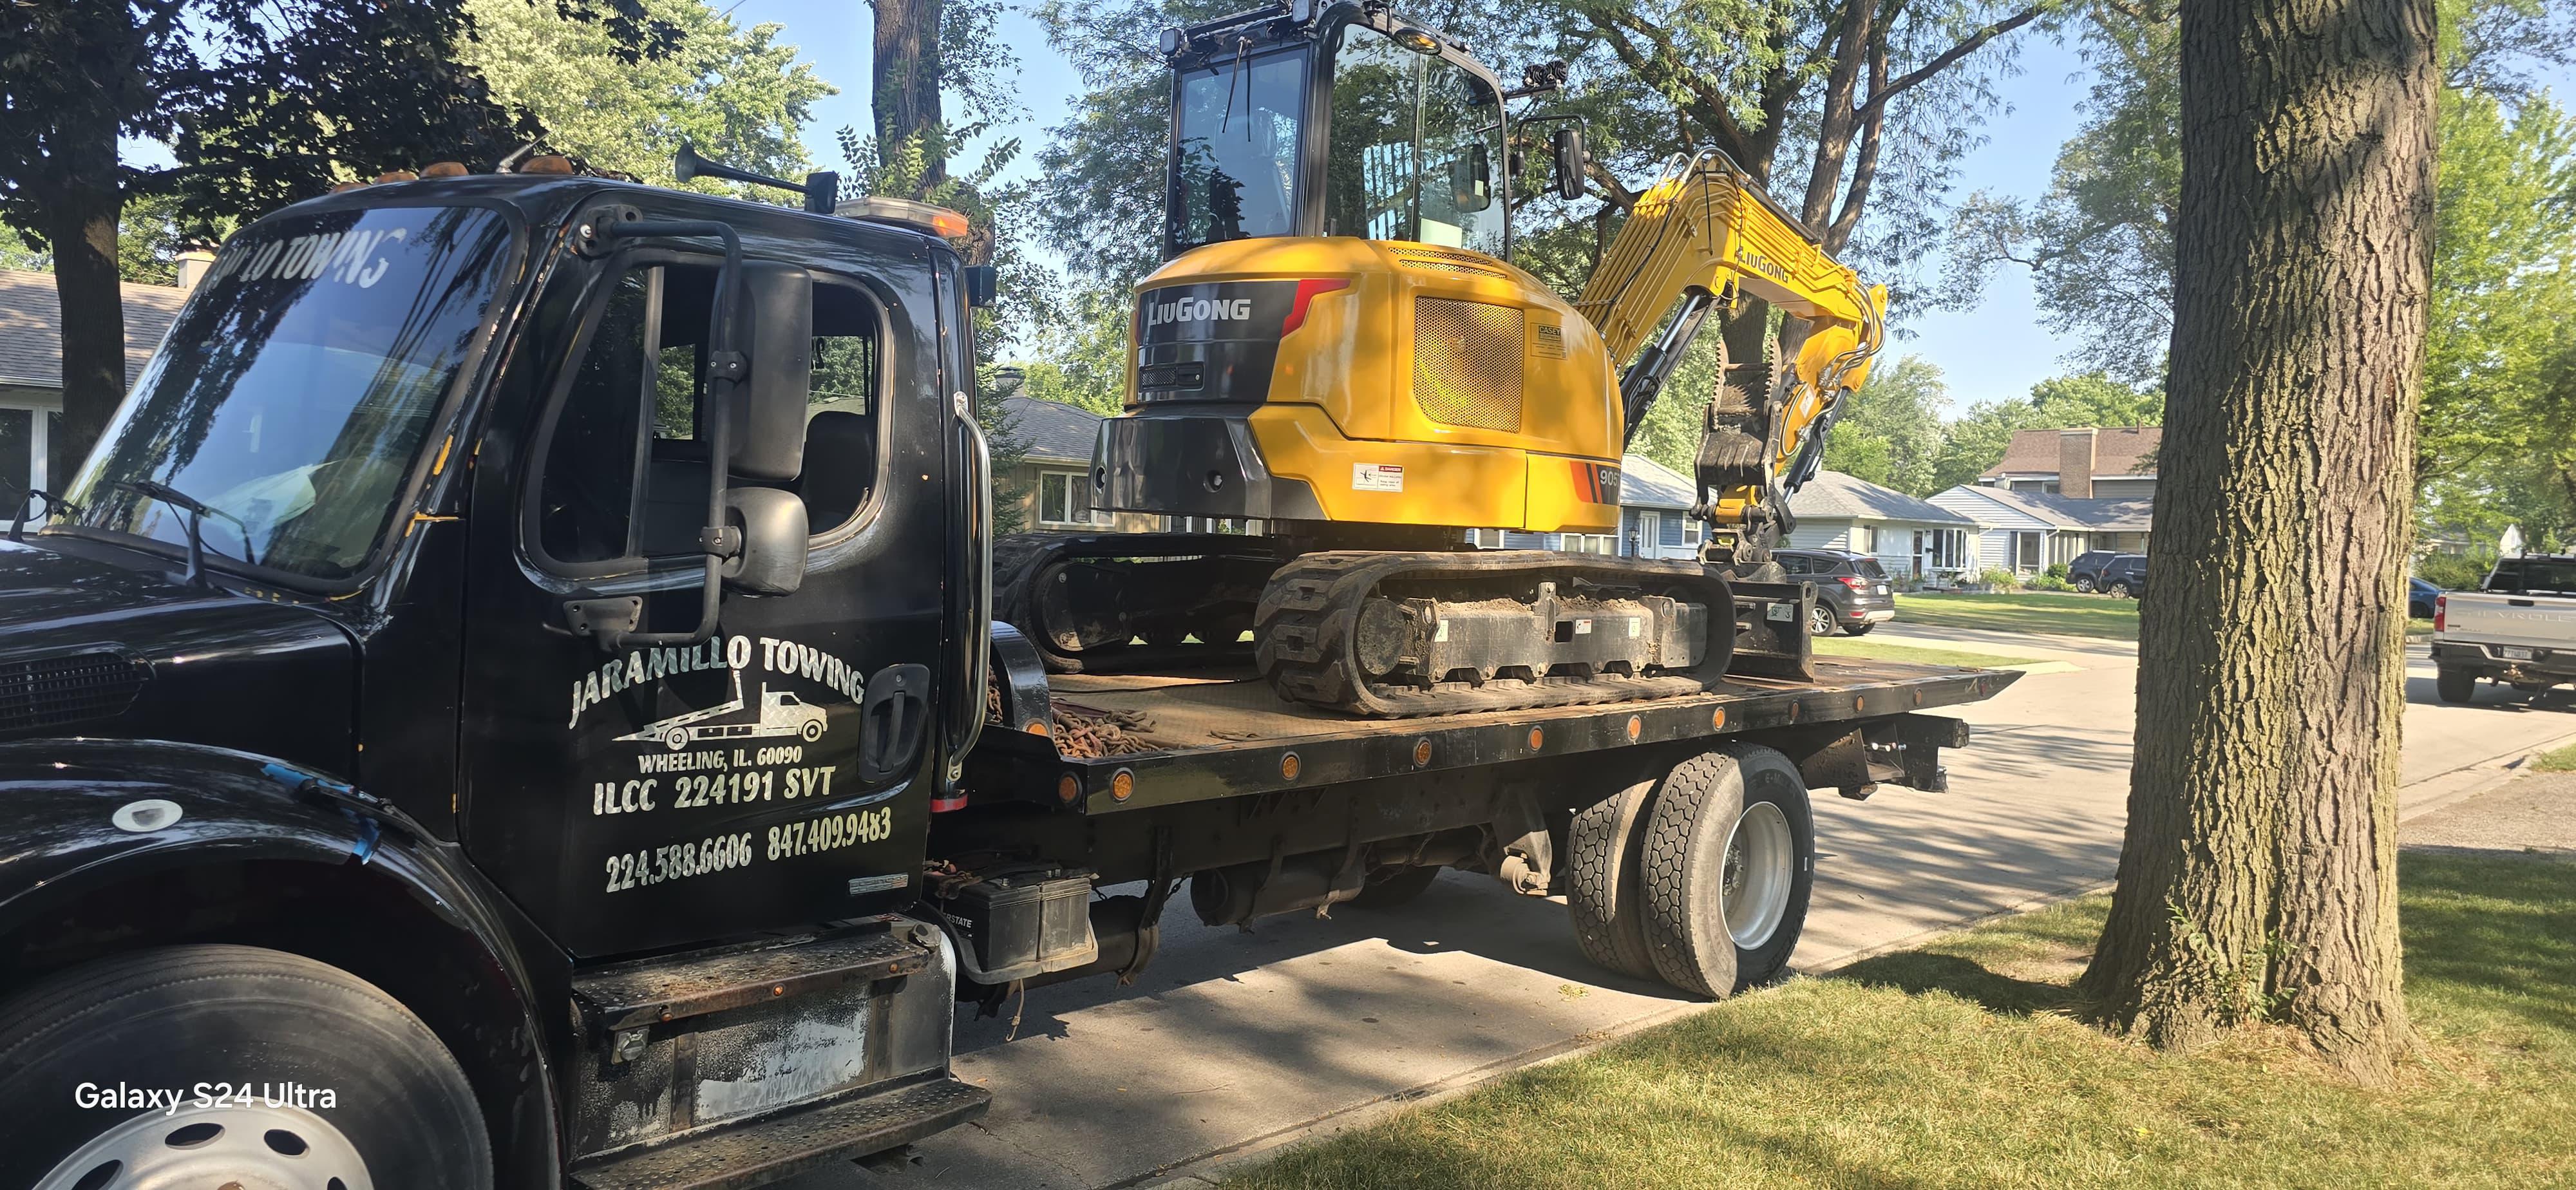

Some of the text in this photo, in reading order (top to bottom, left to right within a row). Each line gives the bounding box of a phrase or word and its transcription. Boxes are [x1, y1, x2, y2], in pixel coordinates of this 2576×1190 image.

[1539, 326, 1560, 335] CASEY
[569, 635, 865, 730] JARAMILLO TOWING
[638, 746, 802, 772] WHEELING, IL. 60090
[592, 765, 837, 816] ILCC 224191 SVT
[605, 806, 892, 893] 224.588.6606 847.409.9483
